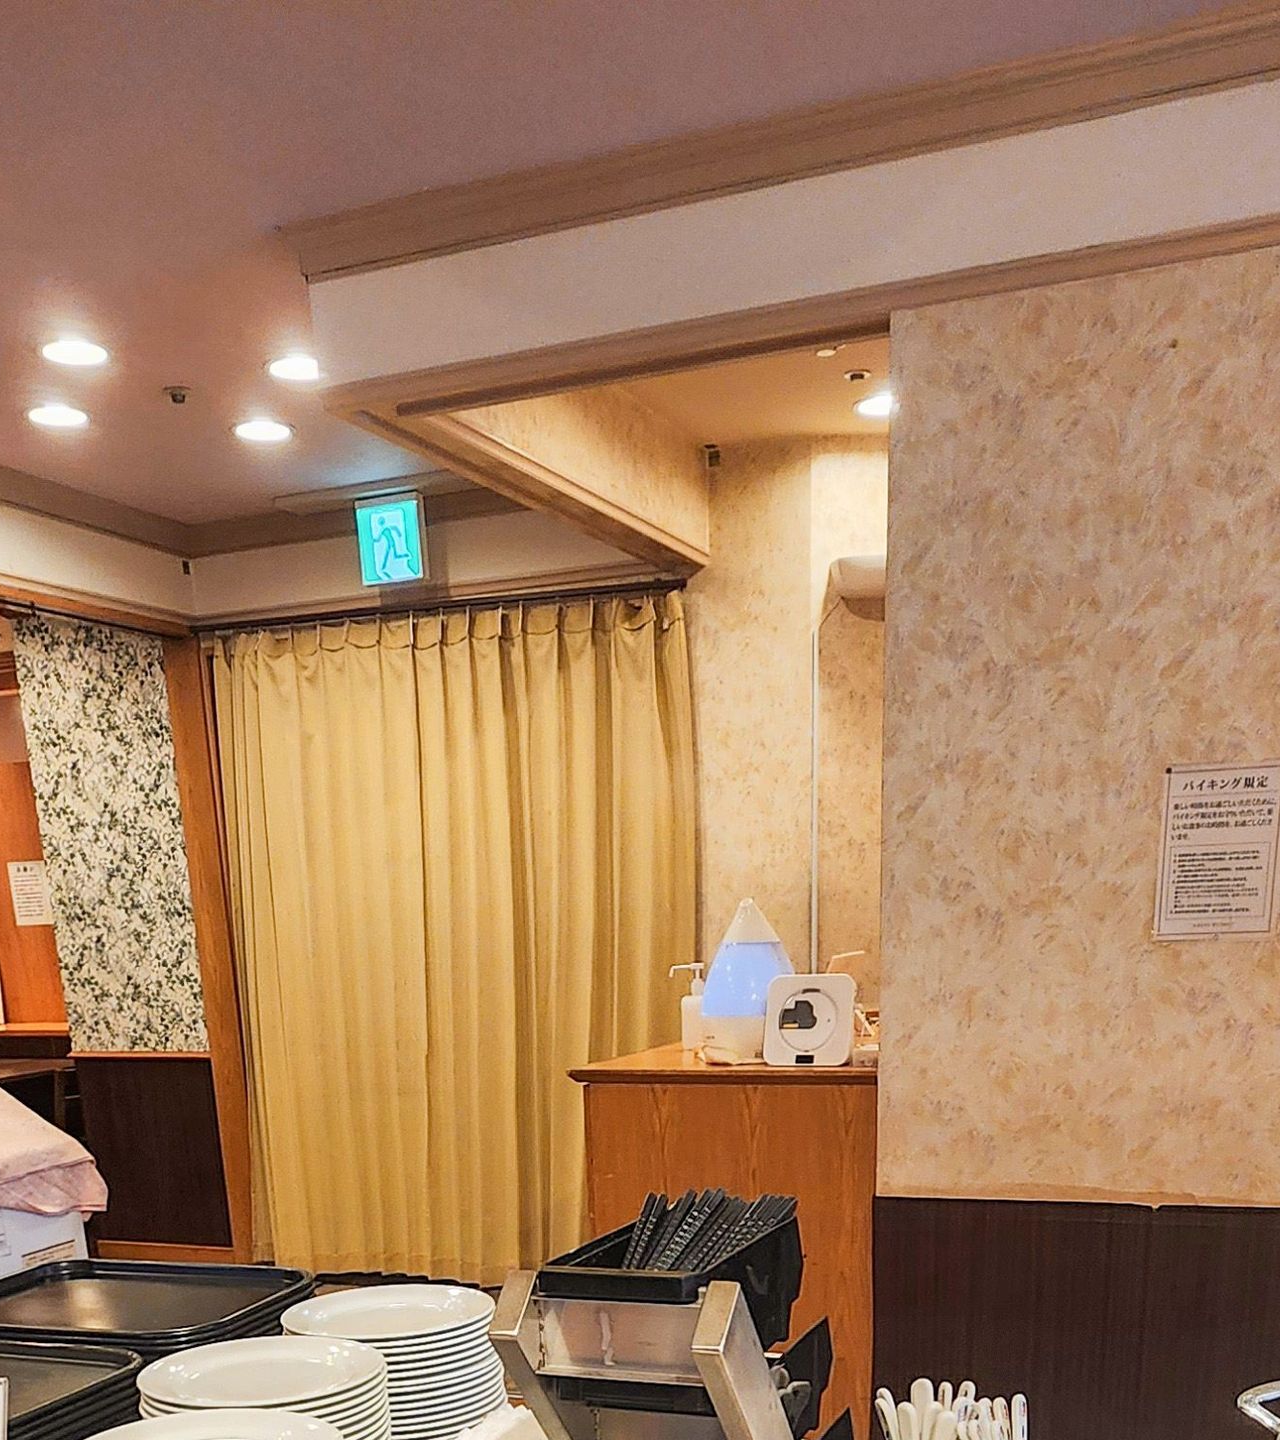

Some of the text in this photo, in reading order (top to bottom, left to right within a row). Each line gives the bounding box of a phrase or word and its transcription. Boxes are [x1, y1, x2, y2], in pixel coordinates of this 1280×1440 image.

[1182, 775, 1269, 791] バイキング規定
